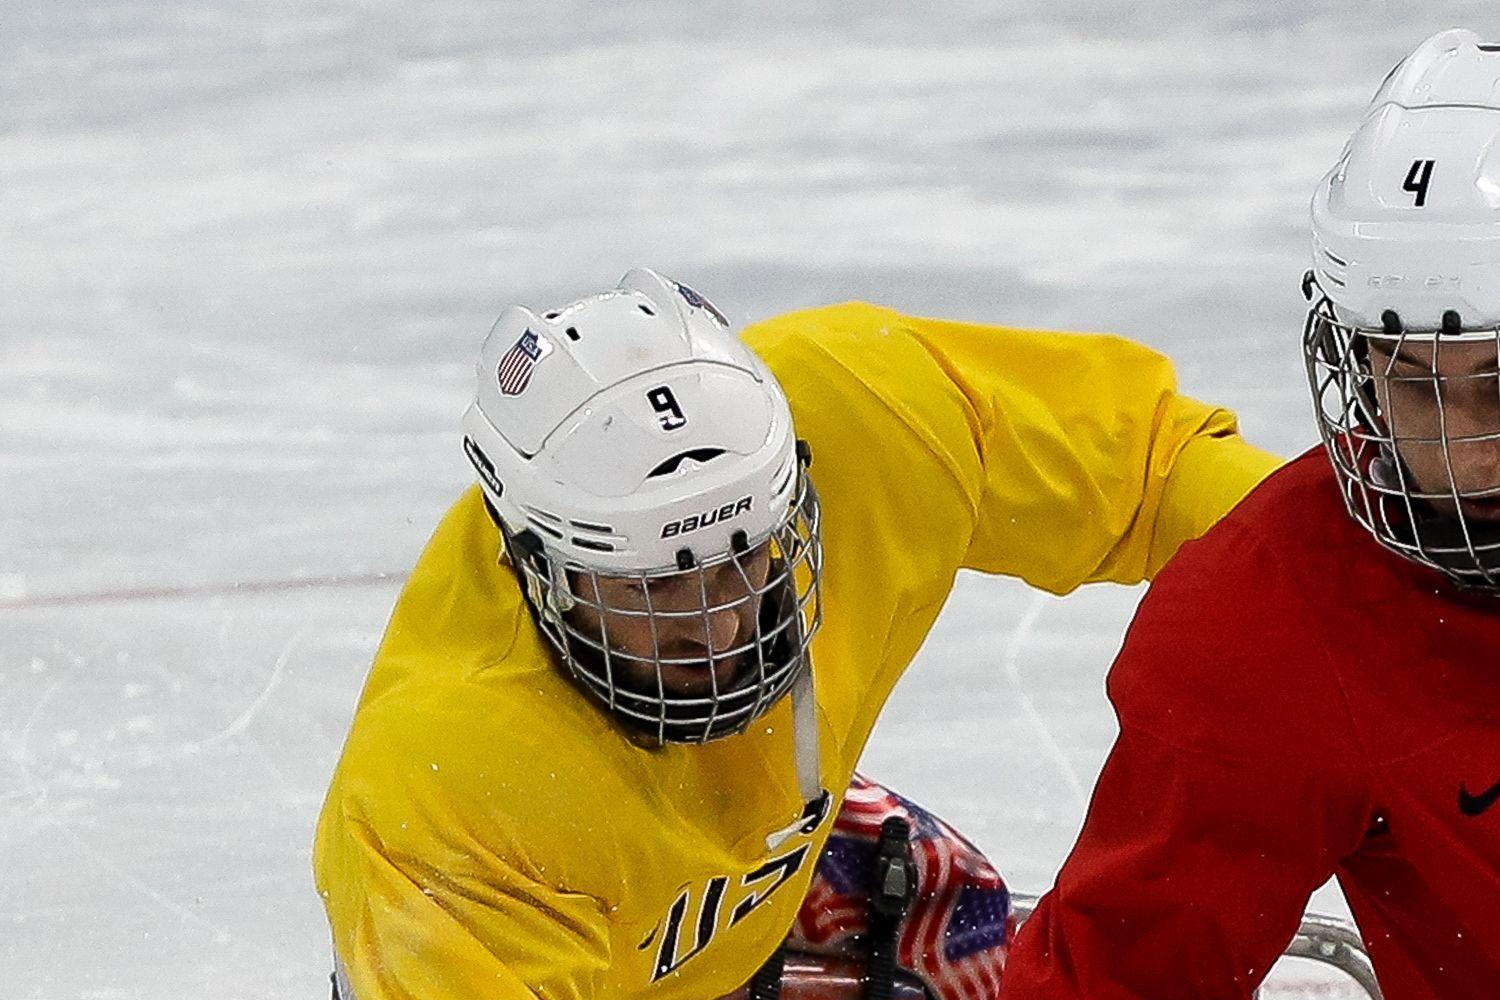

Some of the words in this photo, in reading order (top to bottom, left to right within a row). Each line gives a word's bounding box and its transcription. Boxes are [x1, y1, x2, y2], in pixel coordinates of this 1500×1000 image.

[1402, 159, 1436, 207] 4
[646, 385, 688, 431] 9
[660, 495, 753, 540] BAUER
